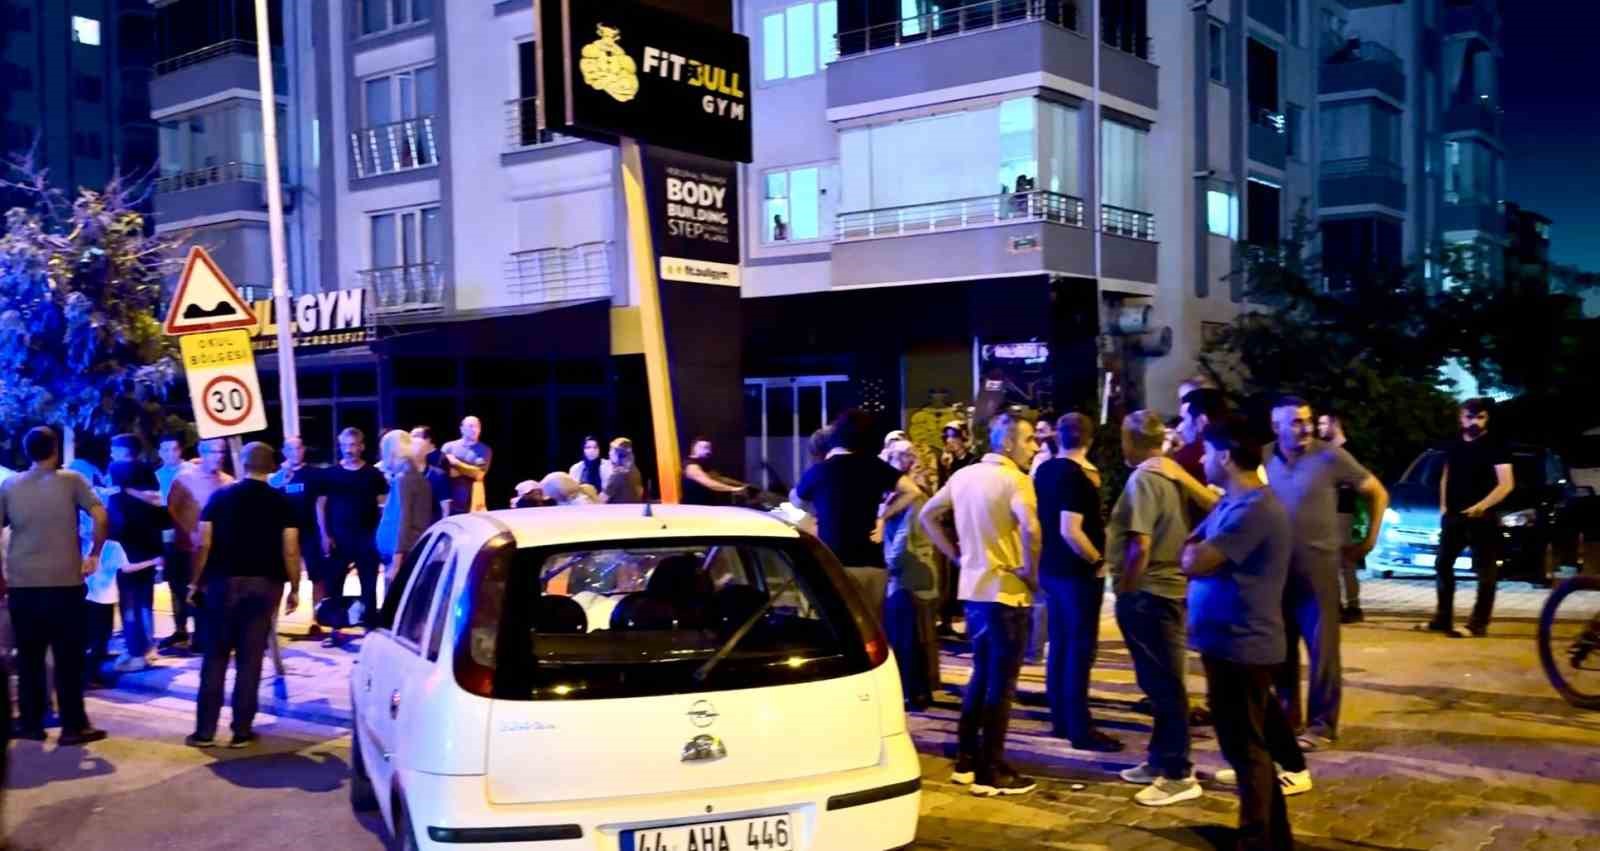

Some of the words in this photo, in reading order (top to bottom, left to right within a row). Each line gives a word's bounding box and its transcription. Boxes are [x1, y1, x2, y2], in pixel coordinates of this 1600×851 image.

[702, 95, 744, 121] GYM
[667, 178, 726, 209] BODY
[667, 203, 729, 225] BUILDING
[668, 219, 704, 238] STEP
[296, 287, 363, 333] GYM
[212, 388, 244, 413] 30
[638, 832, 667, 851] 44
[687, 825, 731, 851] AHA
[747, 819, 789, 849] 446
